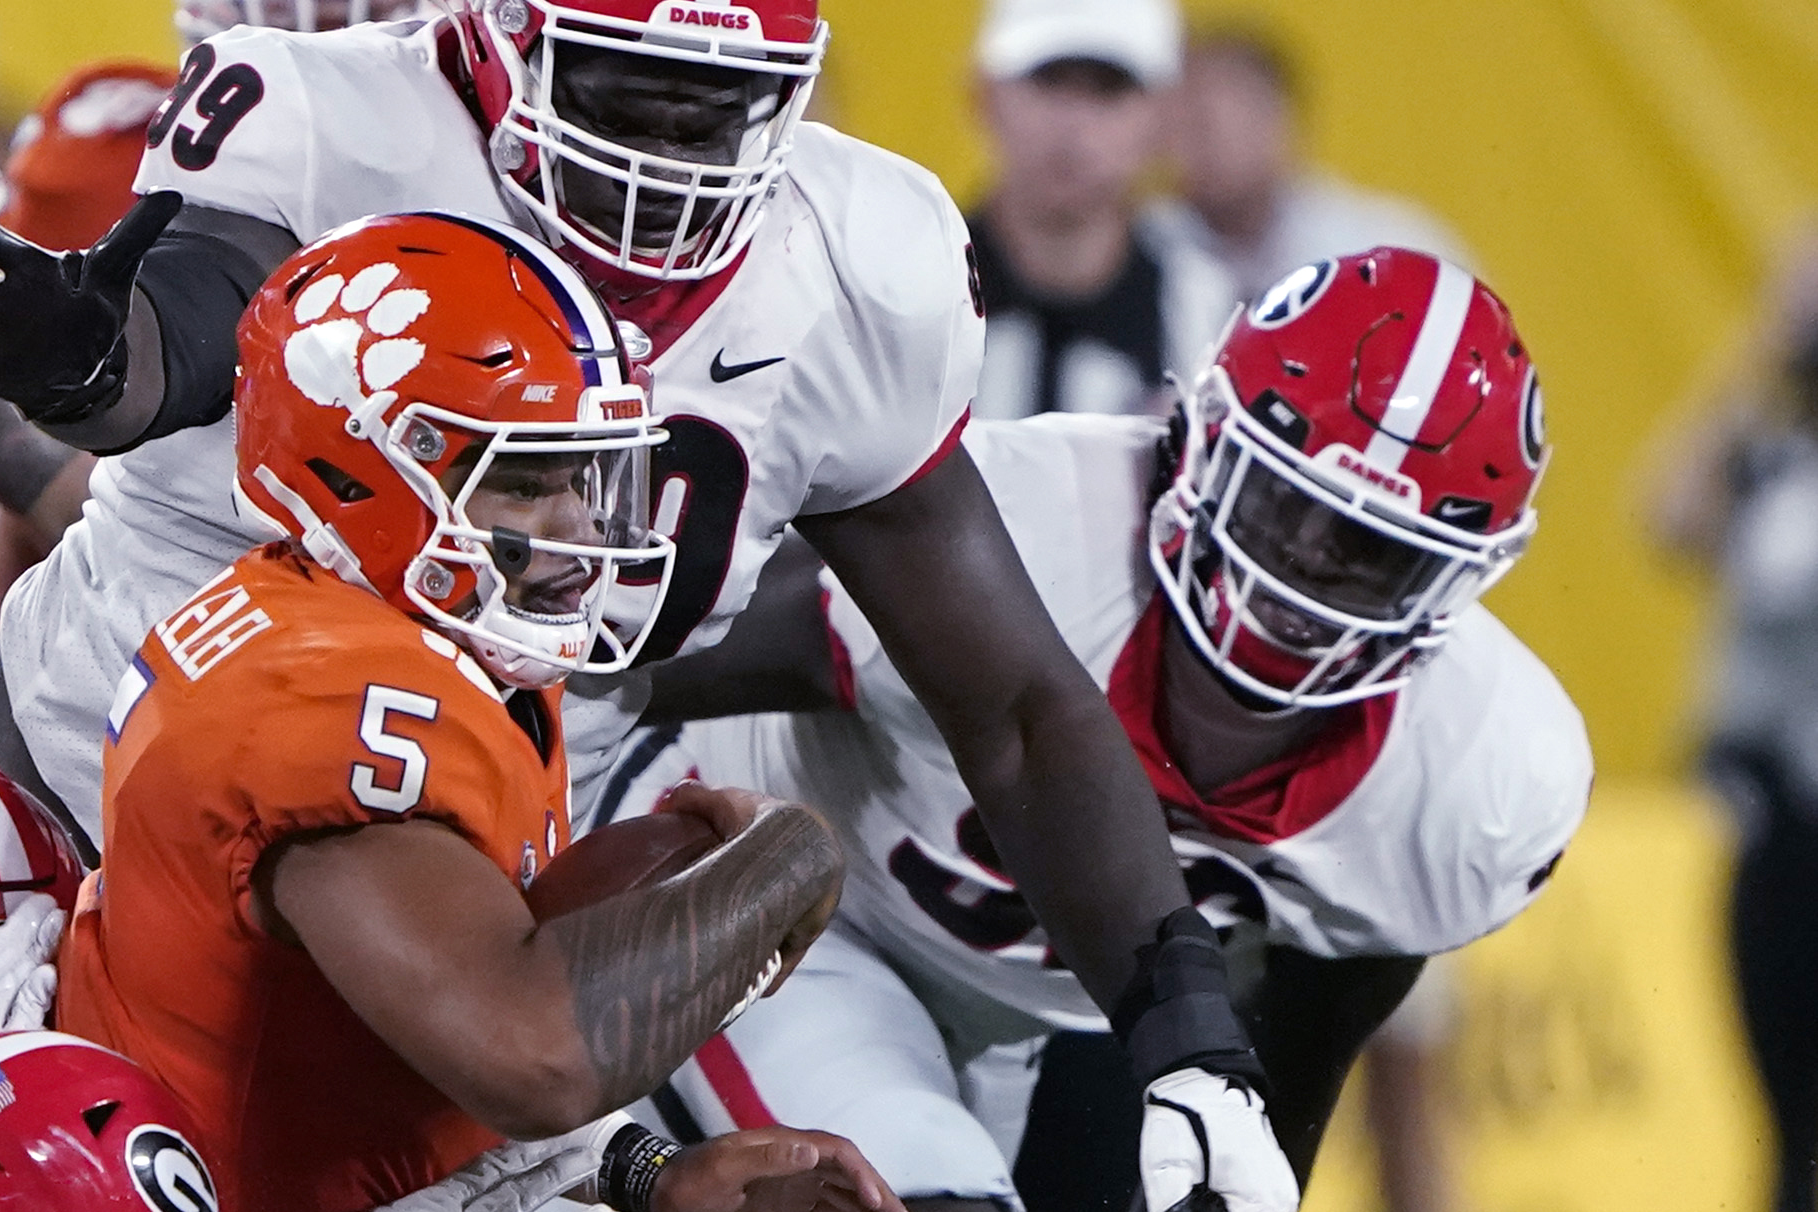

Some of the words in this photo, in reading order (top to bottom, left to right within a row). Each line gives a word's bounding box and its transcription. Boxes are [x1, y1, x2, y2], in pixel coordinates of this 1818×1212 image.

[669, 7, 750, 30] DAWGS
[521, 384, 559, 403] NIKE
[349, 682, 440, 814] 5
